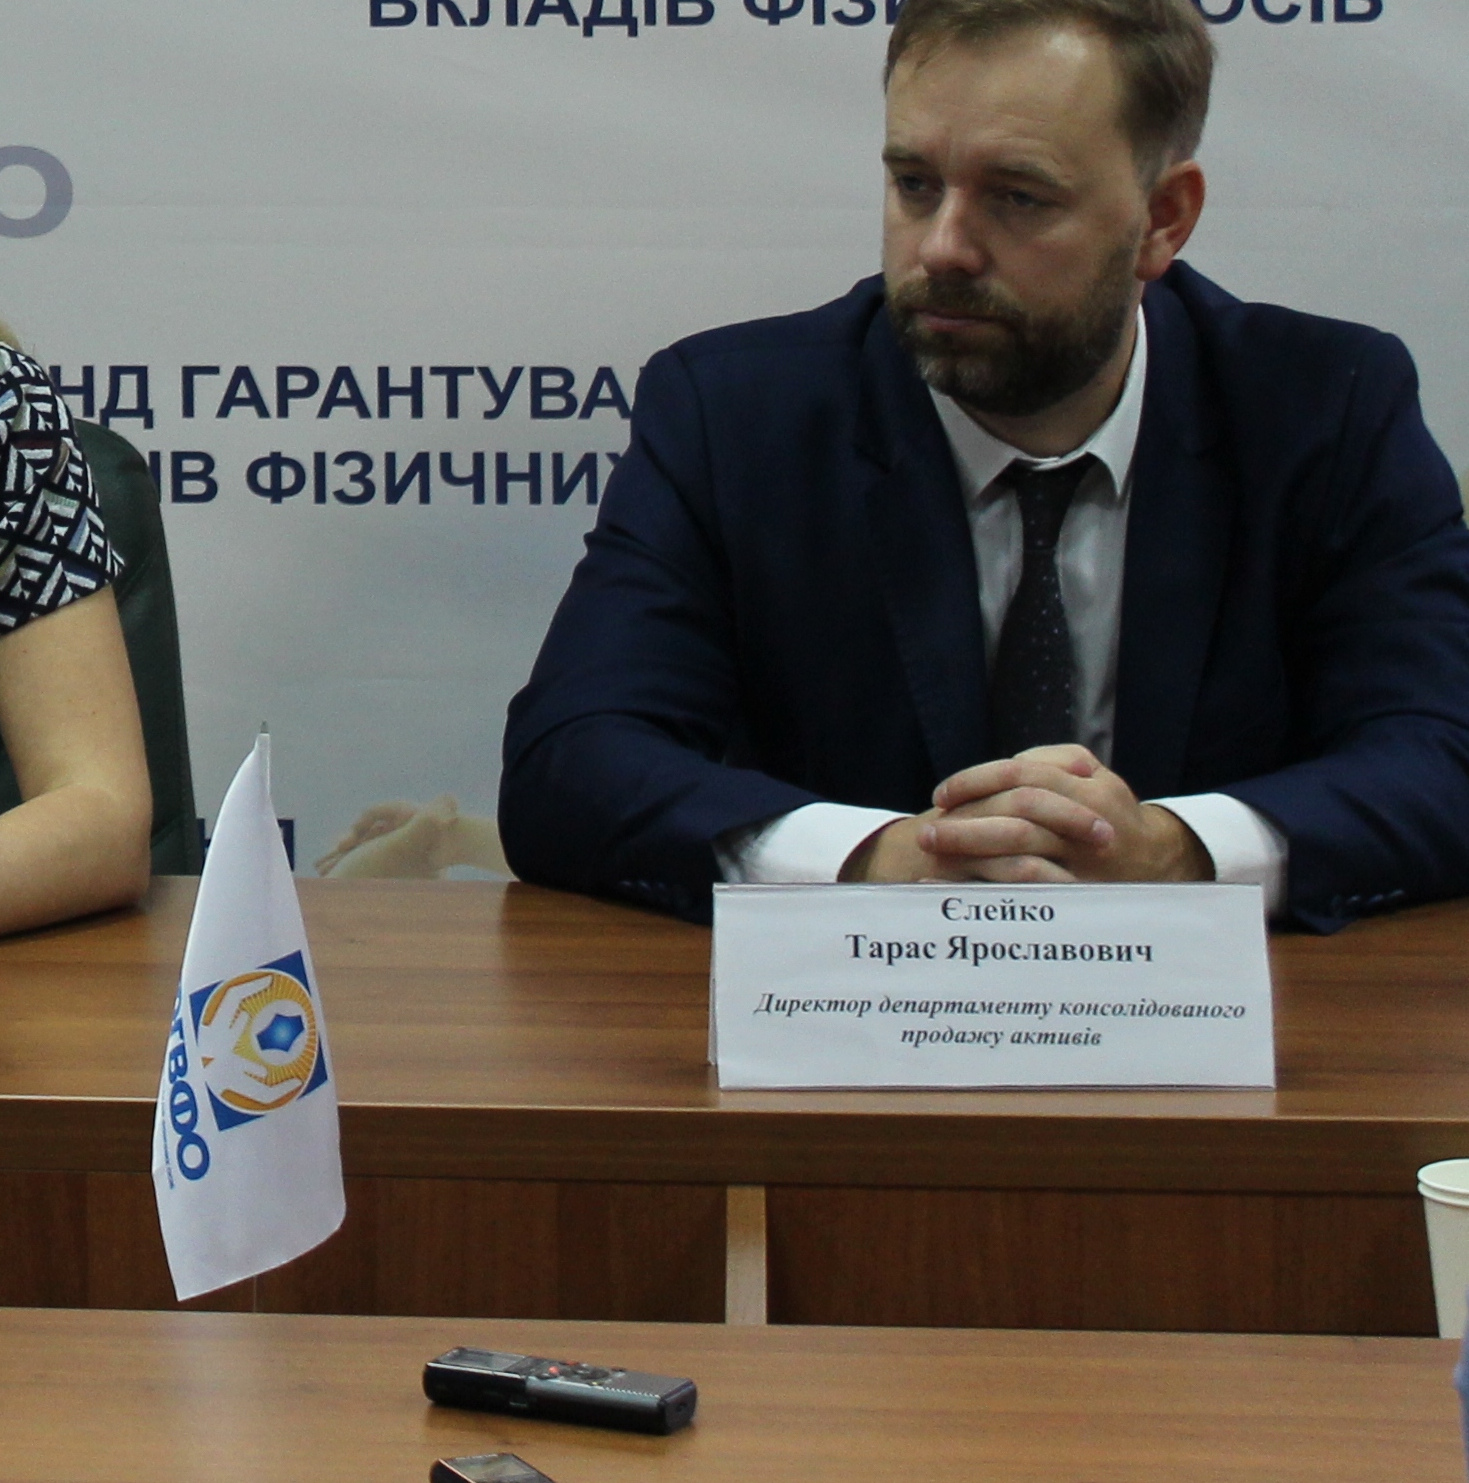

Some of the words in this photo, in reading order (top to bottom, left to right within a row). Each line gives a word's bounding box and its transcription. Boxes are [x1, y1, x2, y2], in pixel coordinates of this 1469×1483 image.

[49, 366, 153, 429] НД
[182, 366, 646, 419] ГАРАНТУВА
[247, 451, 620, 505] ФІЗИЧНИ
[940, 897, 1056, 922] Єлейко
[844, 934, 938, 964] Тарас
[945, 935, 1153, 967] Ярославович
[752, 993, 874, 1018] Директор
[877, 996, 1054, 1021] департаменту
[1057, 997, 1247, 1019] консолідованого
[899, 1026, 1006, 1050] продажу
[1008, 1026, 1103, 1046] активів
